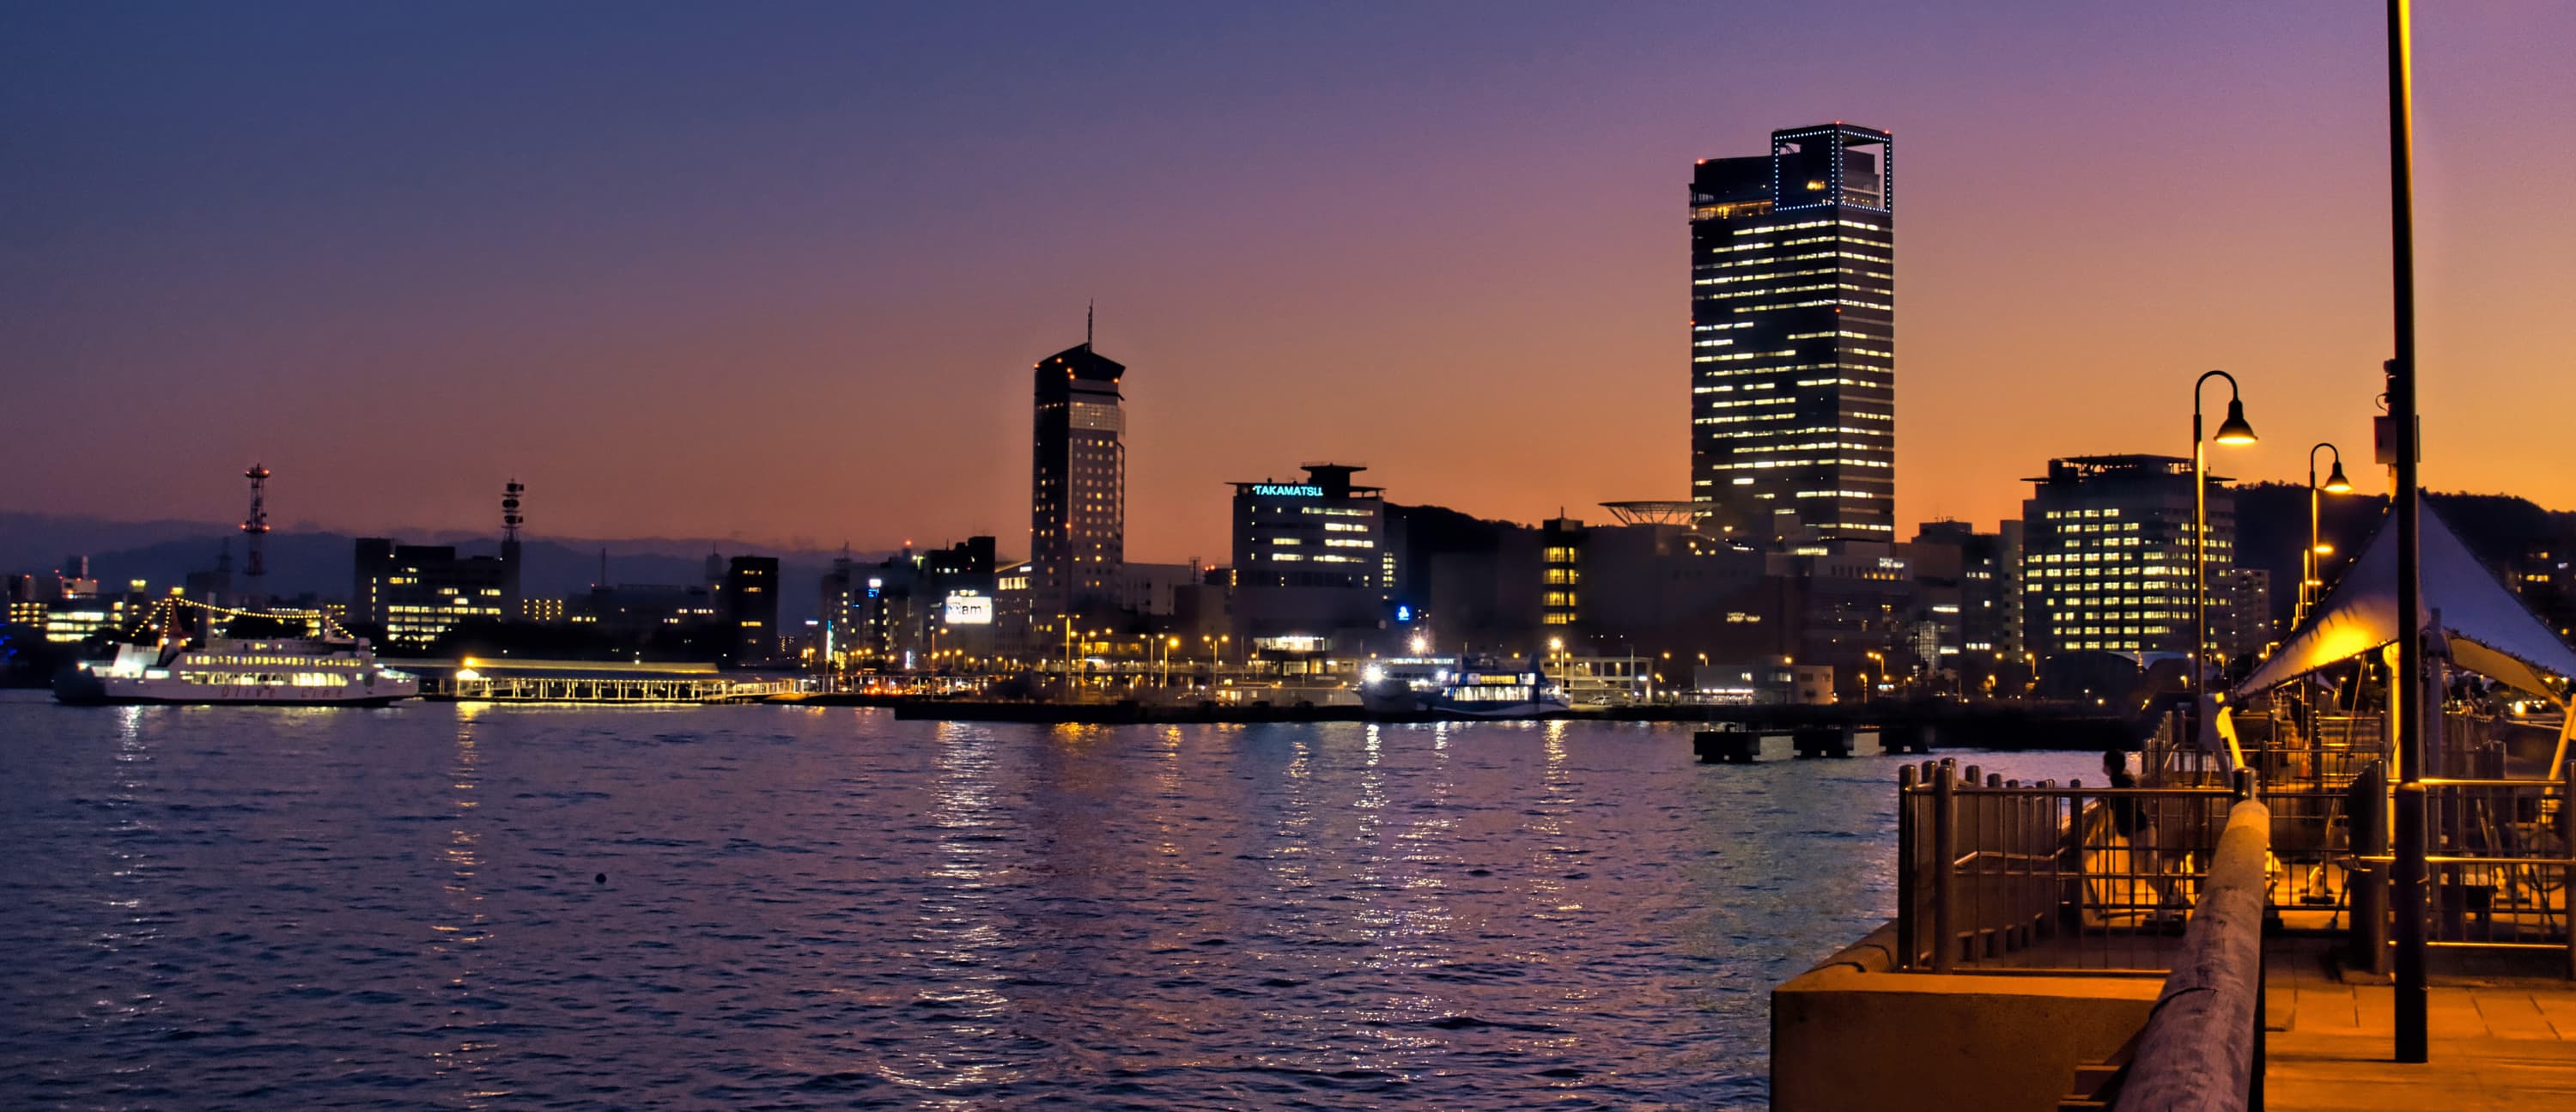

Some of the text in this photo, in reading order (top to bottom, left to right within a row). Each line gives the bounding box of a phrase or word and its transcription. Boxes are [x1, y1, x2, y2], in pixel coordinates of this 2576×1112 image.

[1254, 484, 1321, 496] TAKAMATSU
[221, 684, 343, 698] Olive Line
